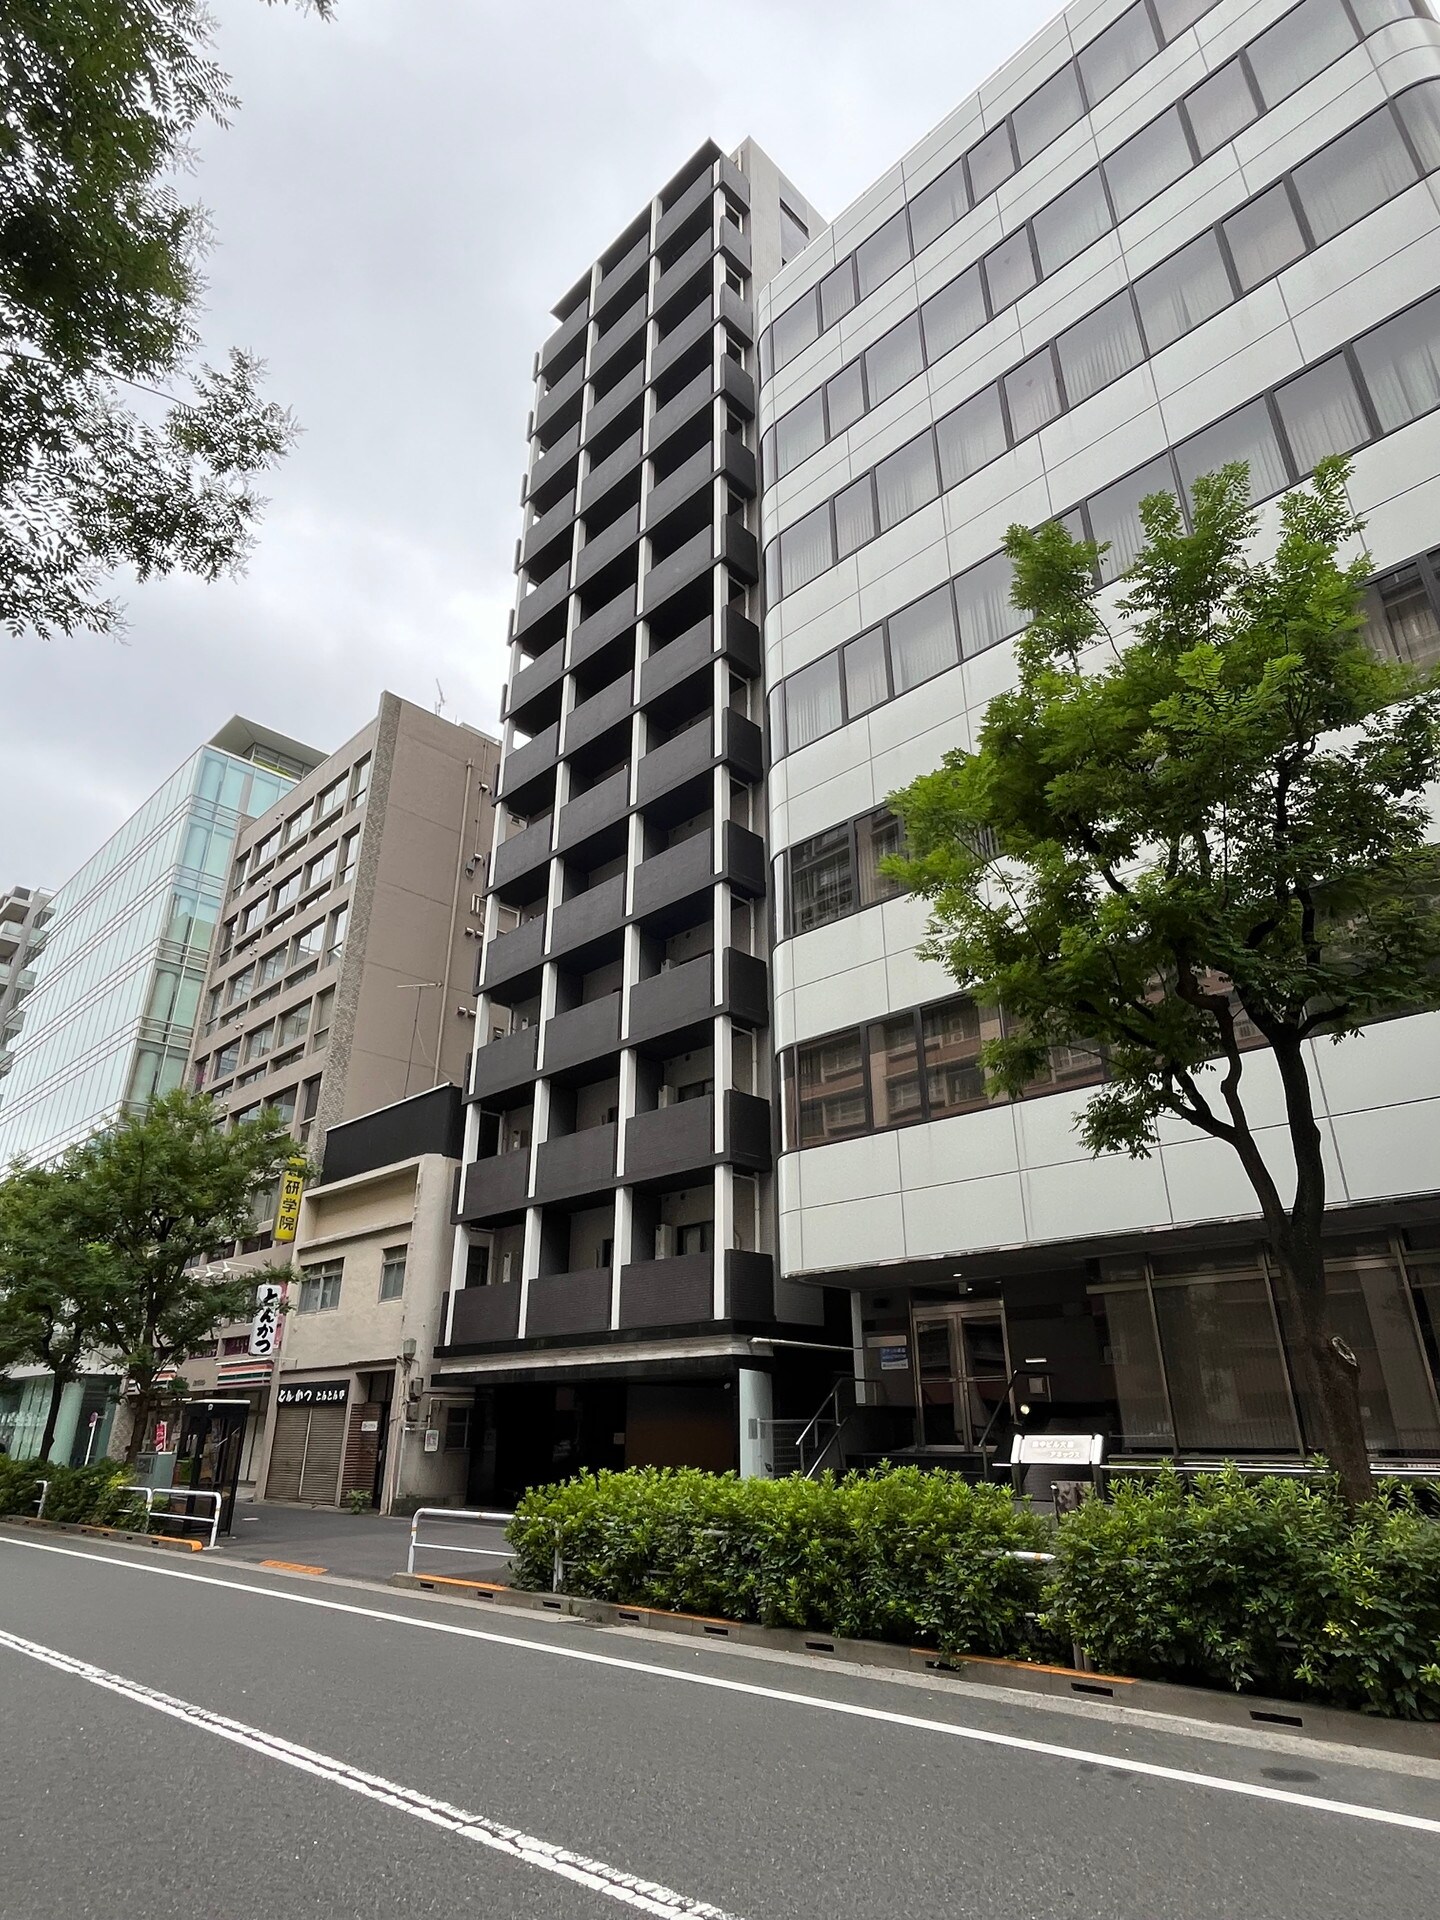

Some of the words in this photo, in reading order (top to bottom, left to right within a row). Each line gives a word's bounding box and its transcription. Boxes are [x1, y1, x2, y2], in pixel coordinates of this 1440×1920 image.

[279, 1164, 305, 1231] 研学院
[255, 1288, 278, 1353] とんかつ
[278, 1389, 313, 1403] とんかつ
